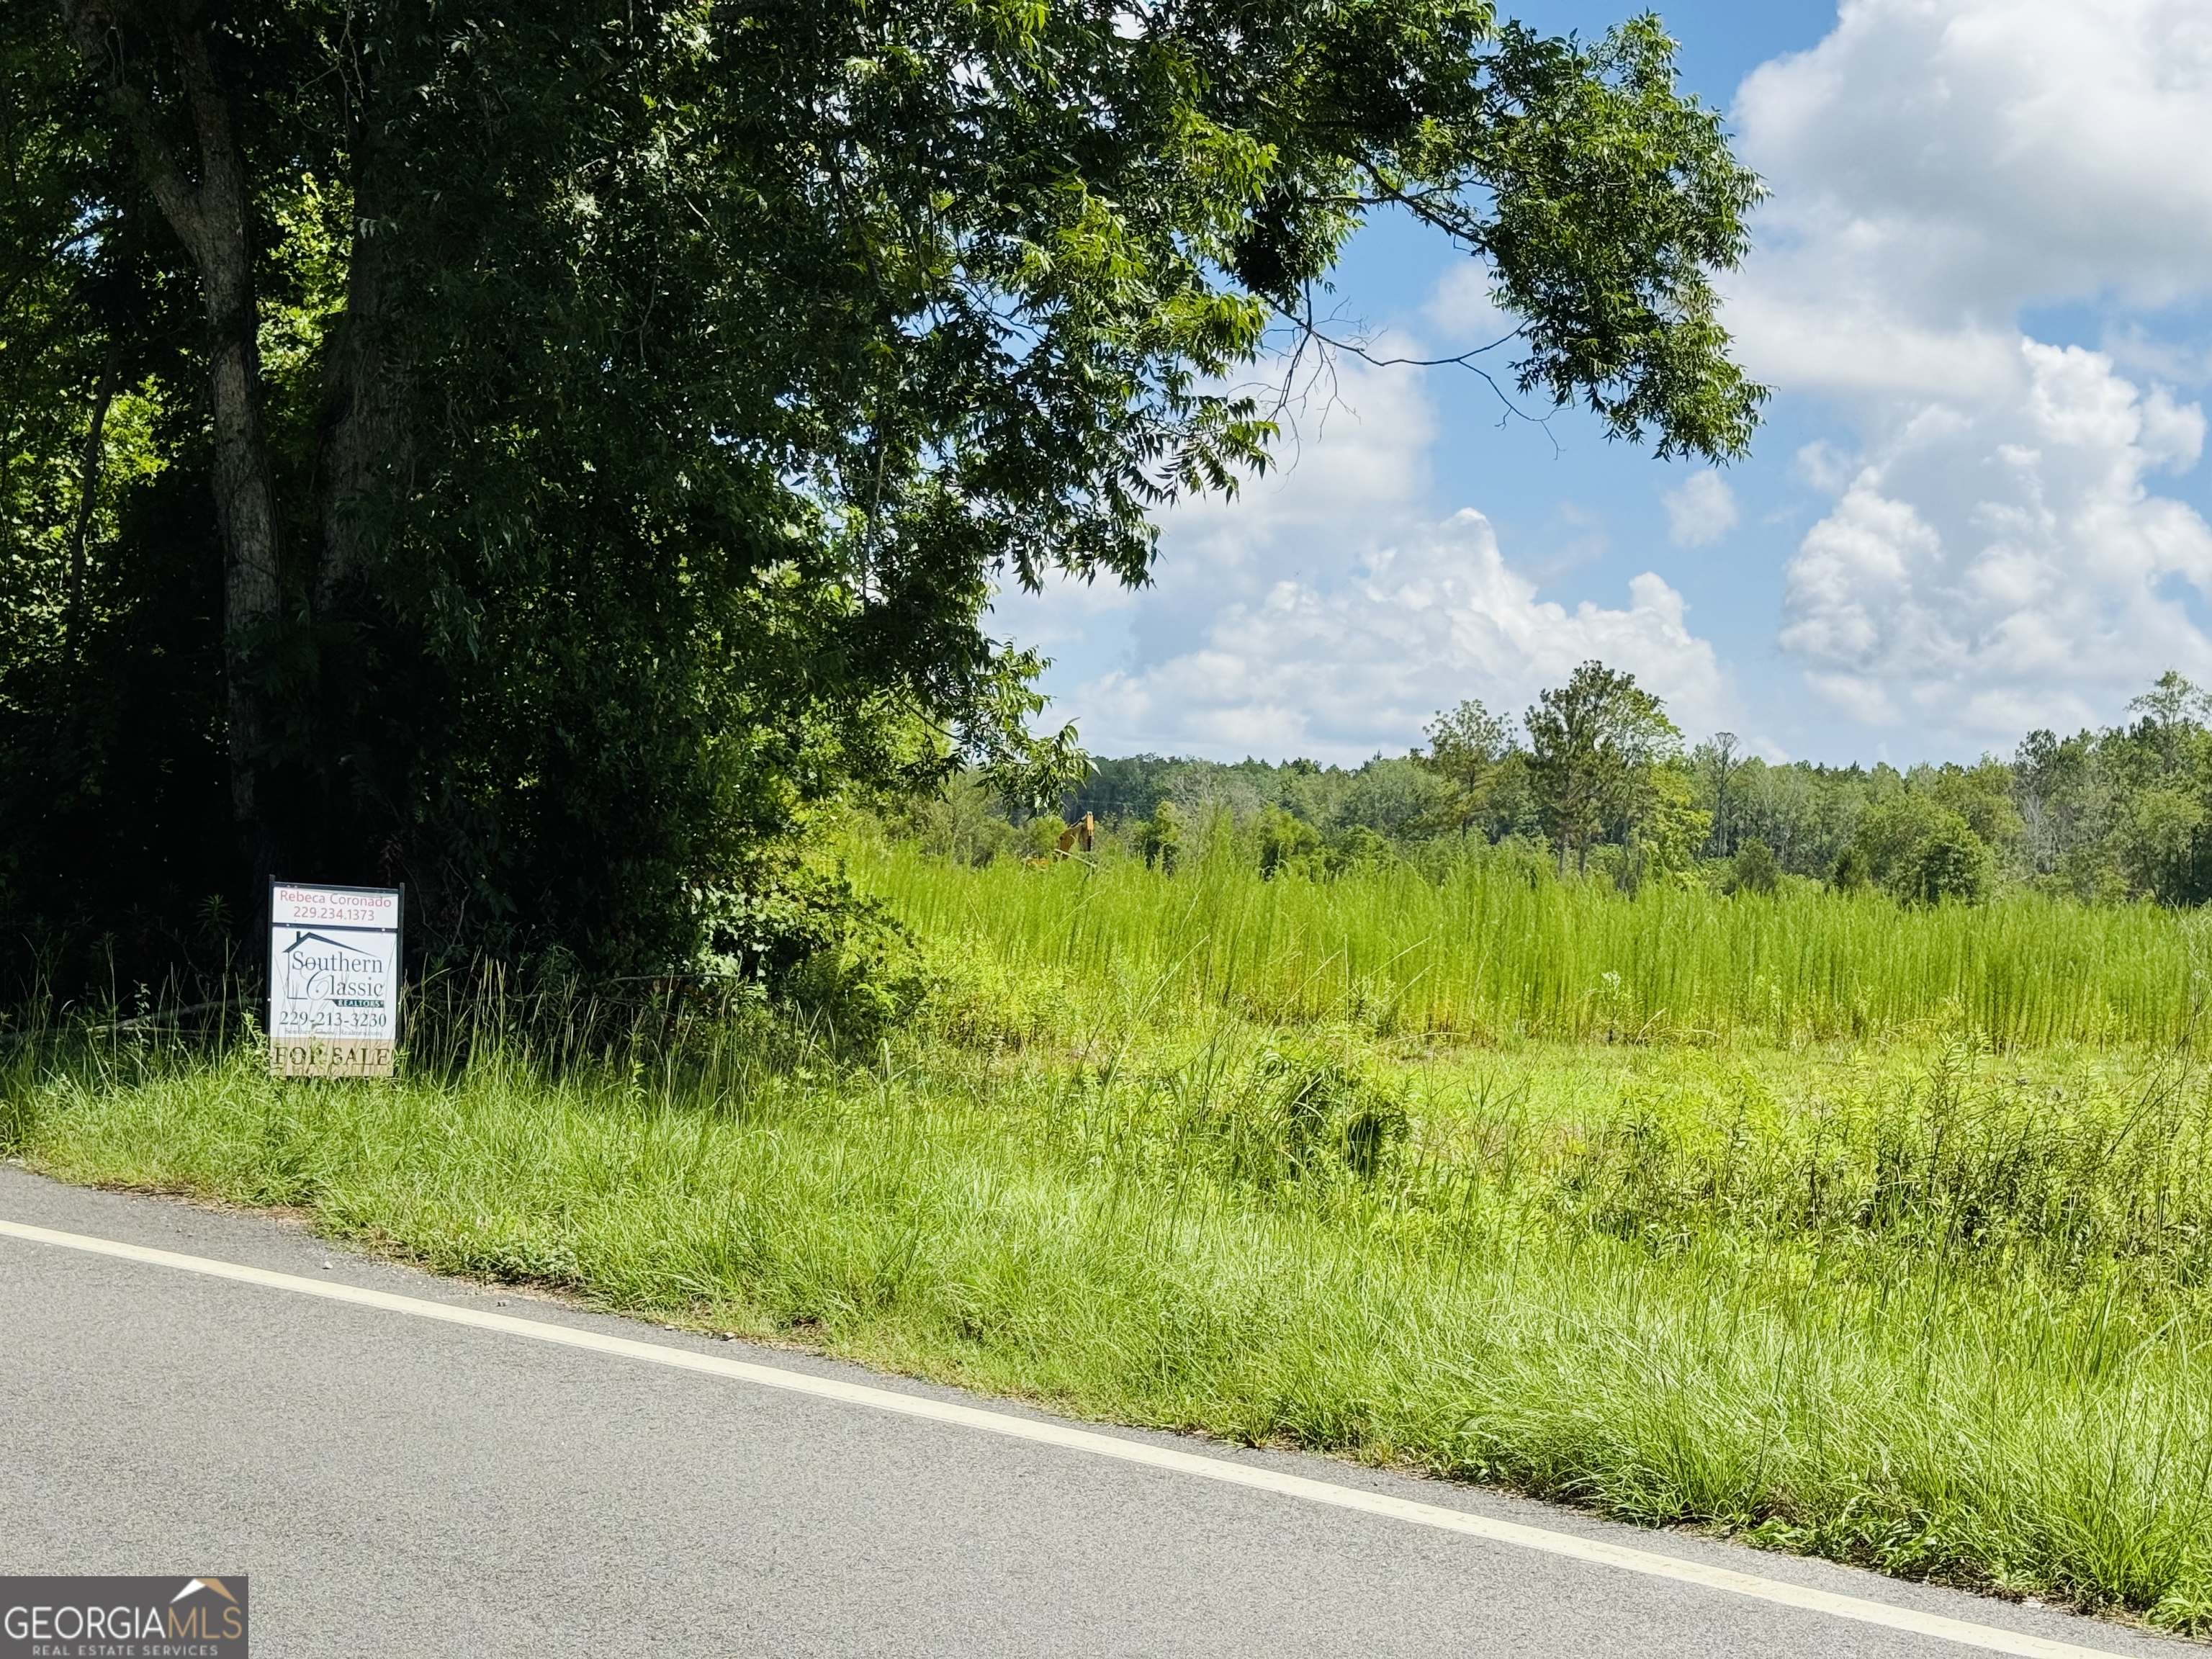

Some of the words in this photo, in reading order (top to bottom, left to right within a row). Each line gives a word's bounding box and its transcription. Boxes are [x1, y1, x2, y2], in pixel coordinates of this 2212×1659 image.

[280, 890, 325, 903] Rebeca
[330, 893, 392, 908] Coronado
[293, 906, 375, 921] 229.234.1373
[292, 950, 384, 973] Southern
[306, 970, 384, 1000] Classic
[279, 1010, 387, 1028] 229-213-3230
[332, 1046, 390, 1066] SALE
